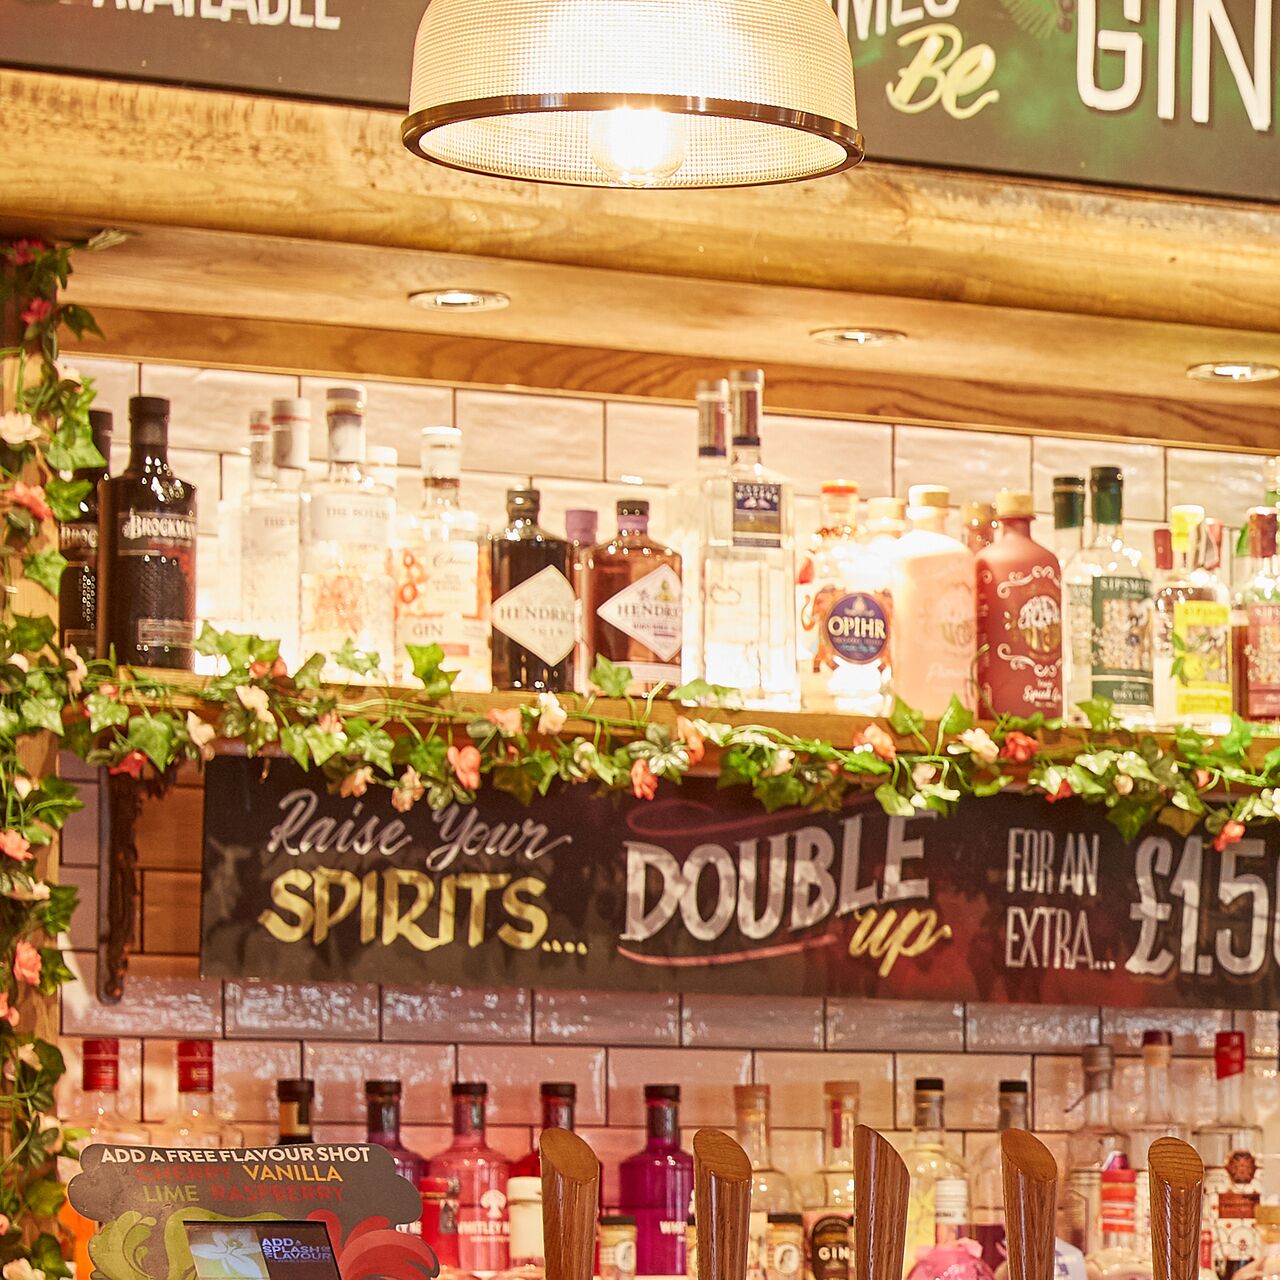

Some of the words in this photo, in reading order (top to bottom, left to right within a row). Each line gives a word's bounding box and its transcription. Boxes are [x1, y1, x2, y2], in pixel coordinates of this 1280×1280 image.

[888, 23, 999, 119] Be
[827, 615, 887, 639] OPIHR
[267, 788, 413, 857] Raise
[425, 803, 573, 872] Your
[620, 811, 937, 943] DOUBLE
[1008, 828, 1056, 895] FOR
[1060, 833, 1099, 897] AN
[849, 906, 951, 978] up
[1005, 905, 1117, 971] EXTRA...
[101, 1148, 146, 1163] ADD
[149, 1150, 166, 1164] A
[168, 1150, 218, 1164] FREE
[221, 1148, 314, 1163] FLAVOUR
[319, 1147, 370, 1163] SHOT
[135, 1165, 231, 1182] CHERRY
[242, 1164, 343, 1182] VANILLA
[143, 1185, 200, 1202] LIME
[209, 1185, 343, 1202] RASPBERRY
[262, 1238, 294, 1247] ADD
[264, 1252, 332, 1260] FLAVOUR
